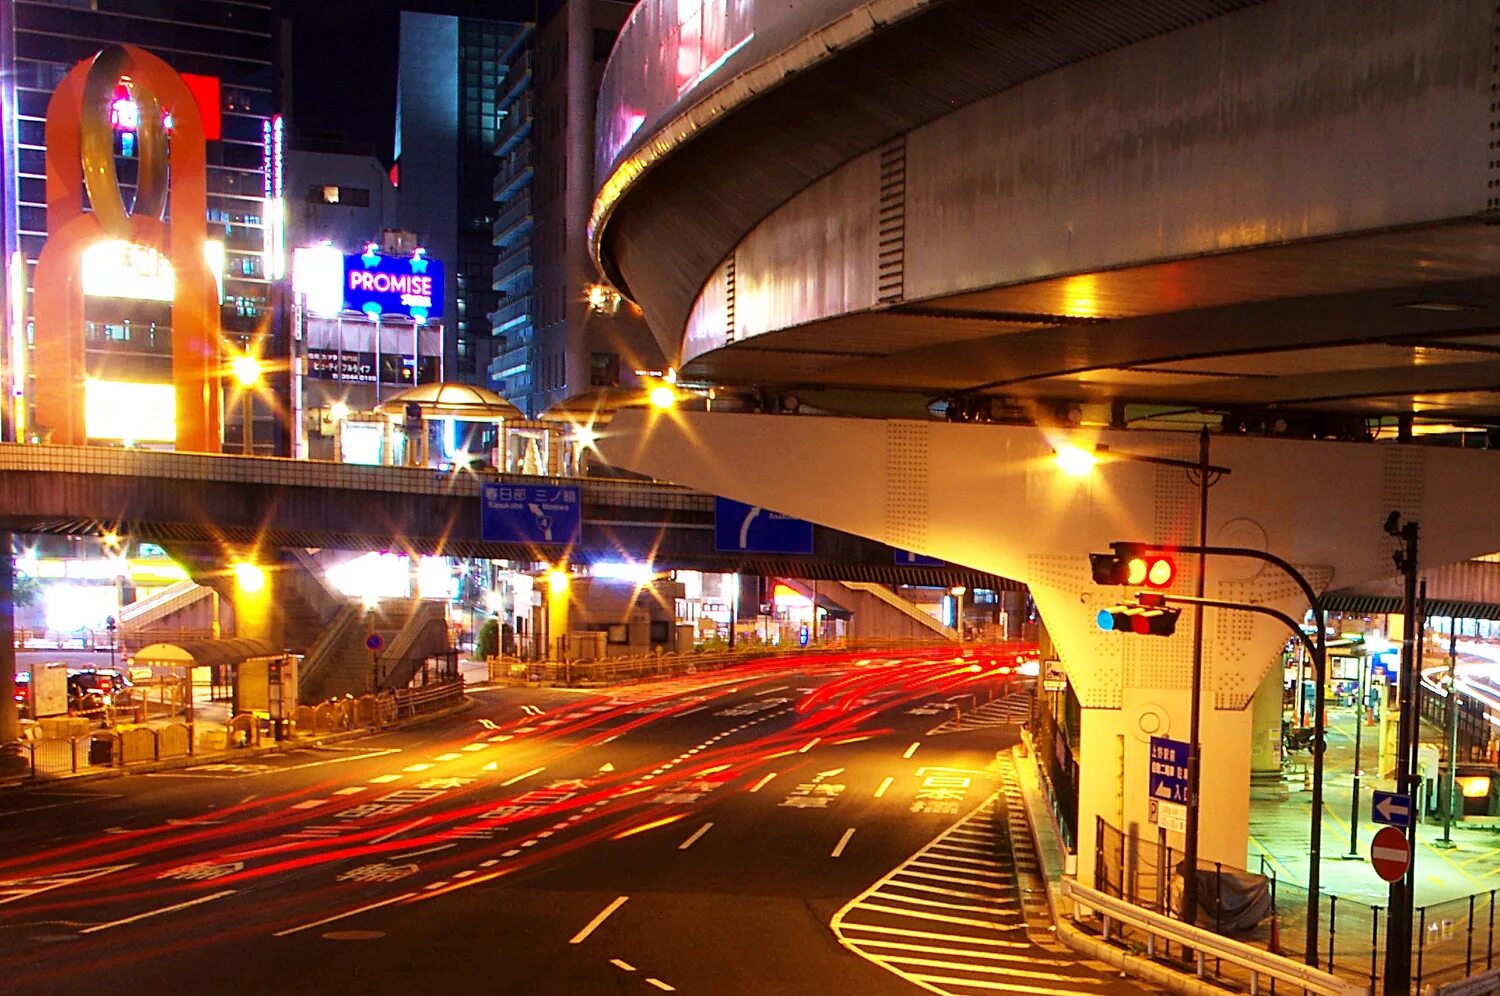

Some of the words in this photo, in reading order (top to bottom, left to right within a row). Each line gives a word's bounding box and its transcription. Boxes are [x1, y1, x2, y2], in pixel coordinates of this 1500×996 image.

[350, 271, 432, 295] PROMISE
[486, 487, 526, 501] 春日部
[535, 489, 576, 503] 三ノ輪
